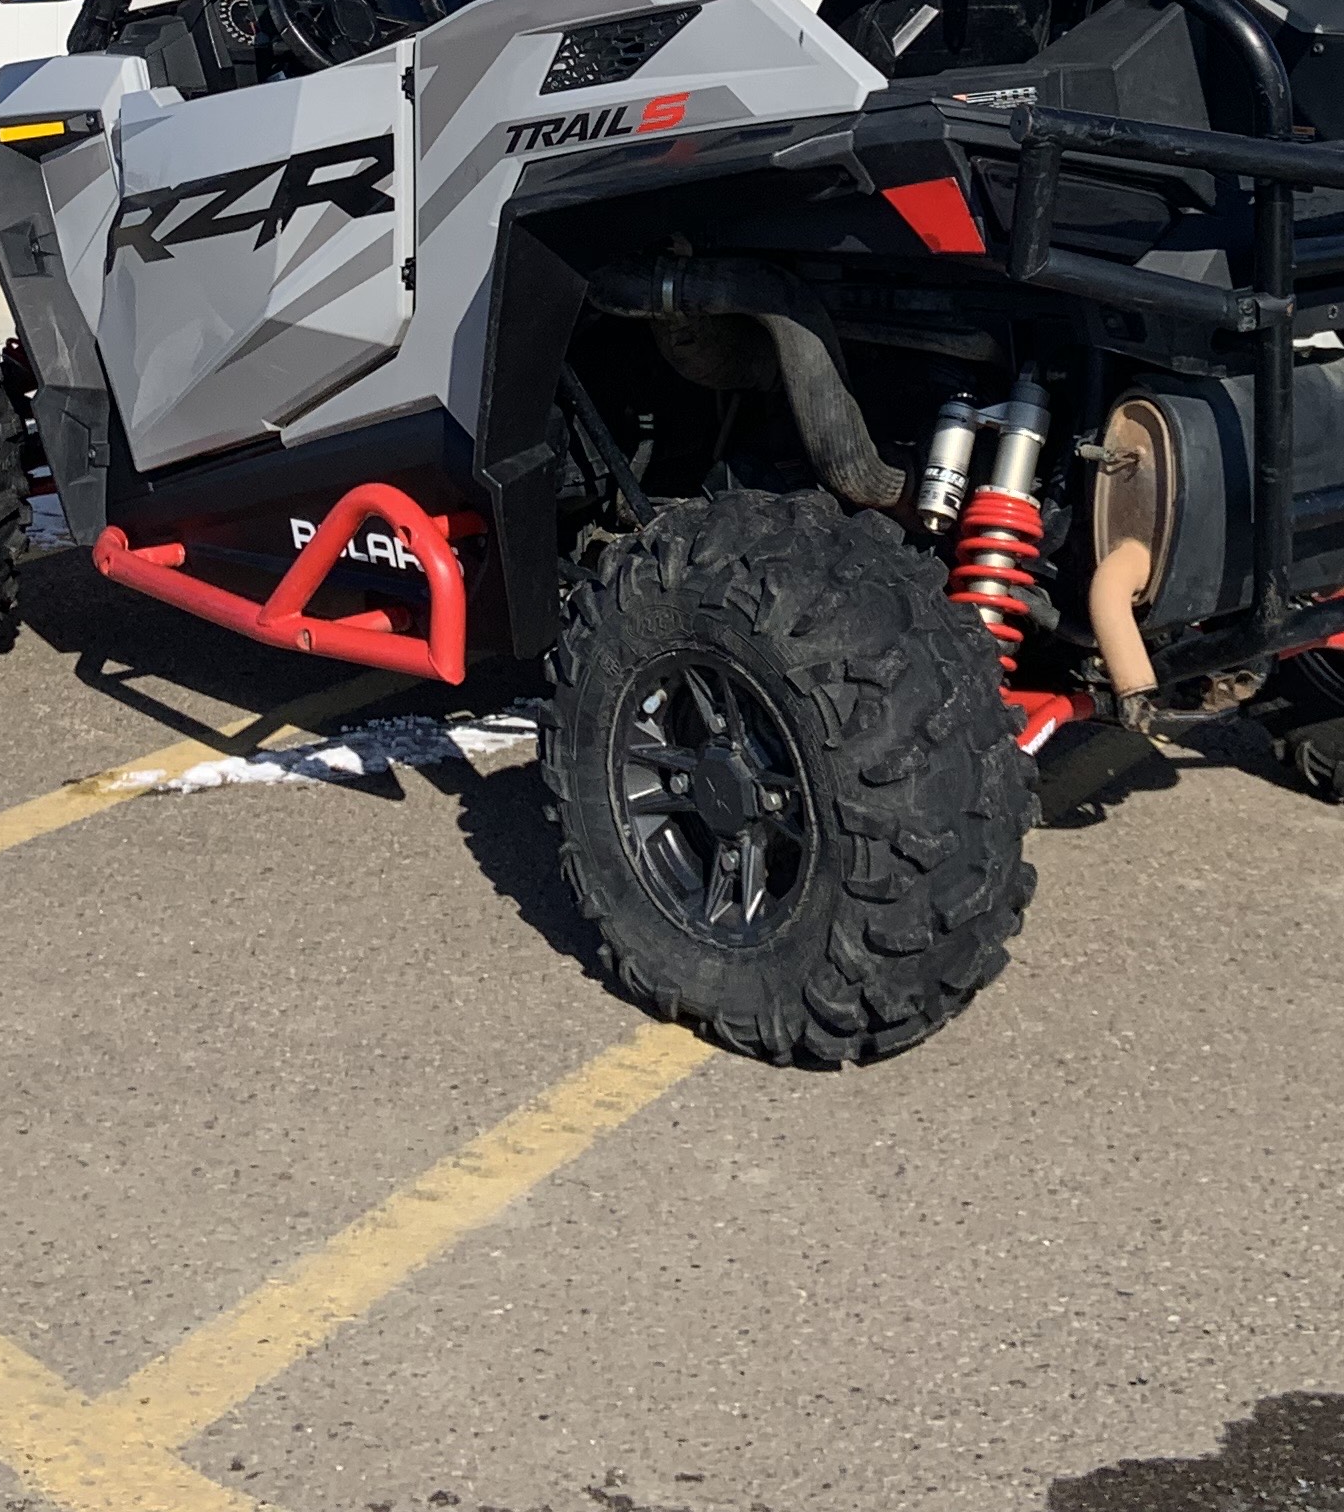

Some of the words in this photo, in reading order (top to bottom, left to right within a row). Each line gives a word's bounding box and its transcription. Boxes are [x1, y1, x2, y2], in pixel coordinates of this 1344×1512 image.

[505, 105, 634, 155] TRAIL
[635, 91, 692, 135] S
[106, 133, 395, 276] RZR
[289, 517, 465, 578] PLAR
